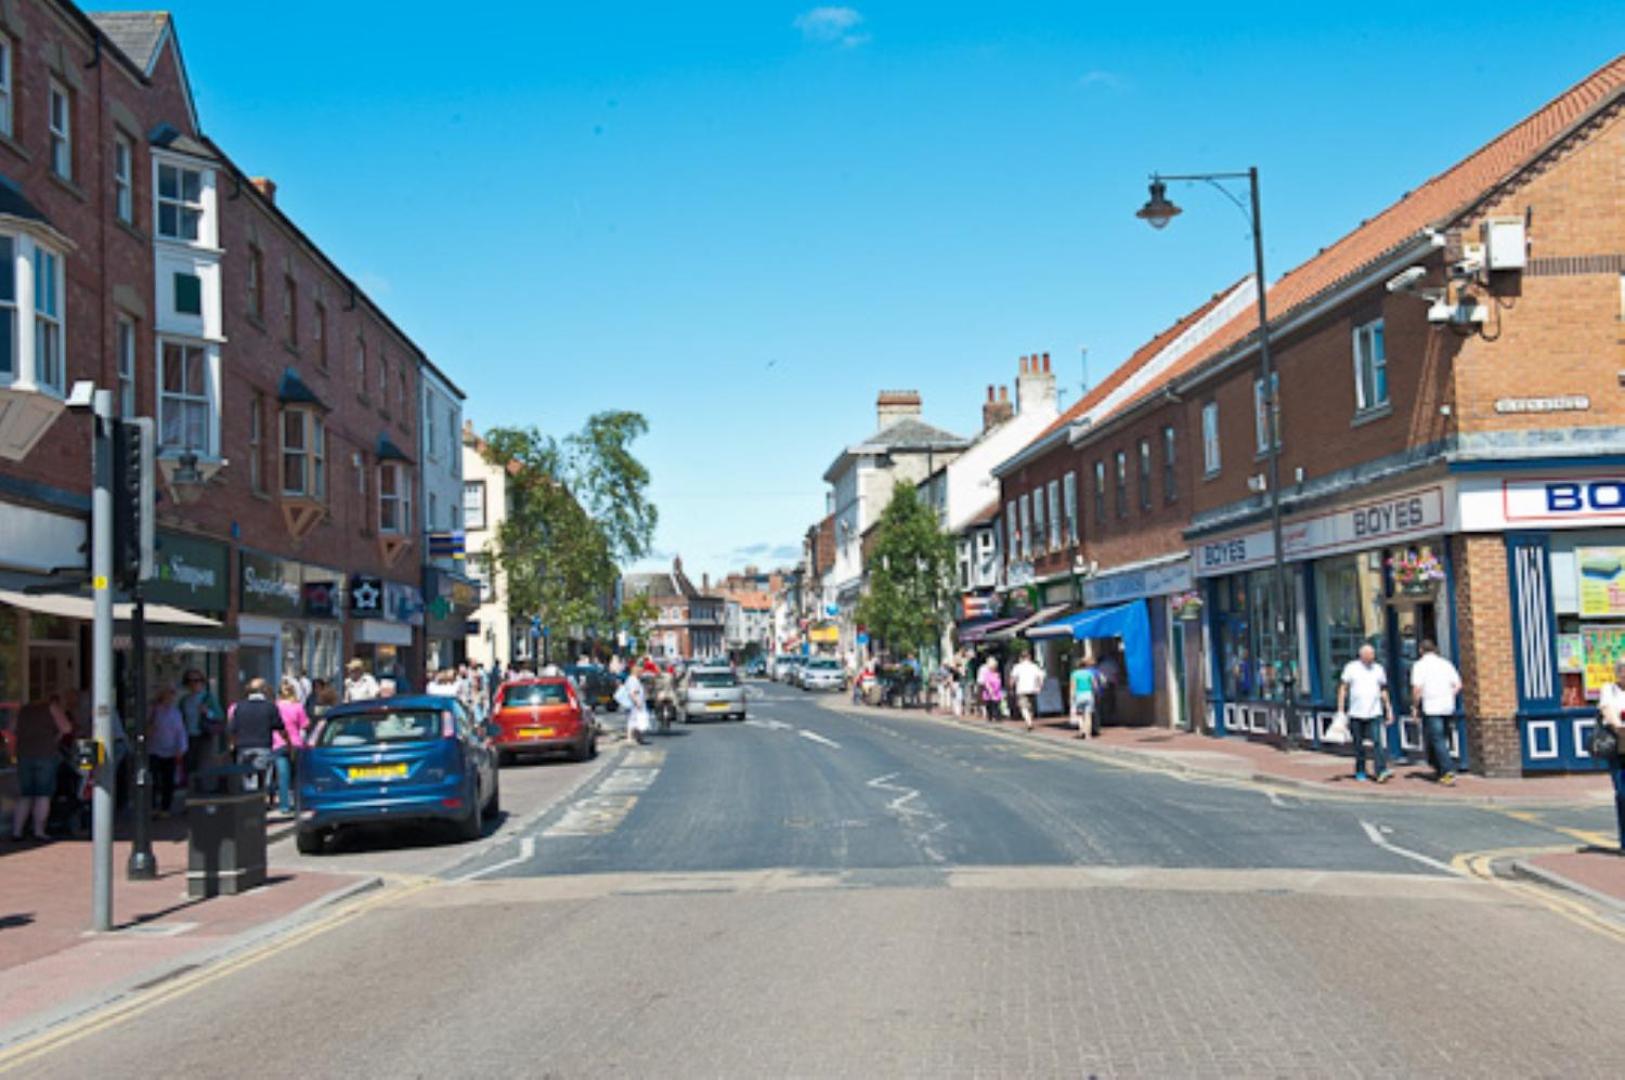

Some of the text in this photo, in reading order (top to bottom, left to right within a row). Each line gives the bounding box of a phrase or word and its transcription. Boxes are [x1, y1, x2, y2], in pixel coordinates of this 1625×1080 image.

[1545, 481, 1625, 512] BO
[1353, 498, 1423, 536] BOYES
[1204, 540, 1246, 566] BOYES
